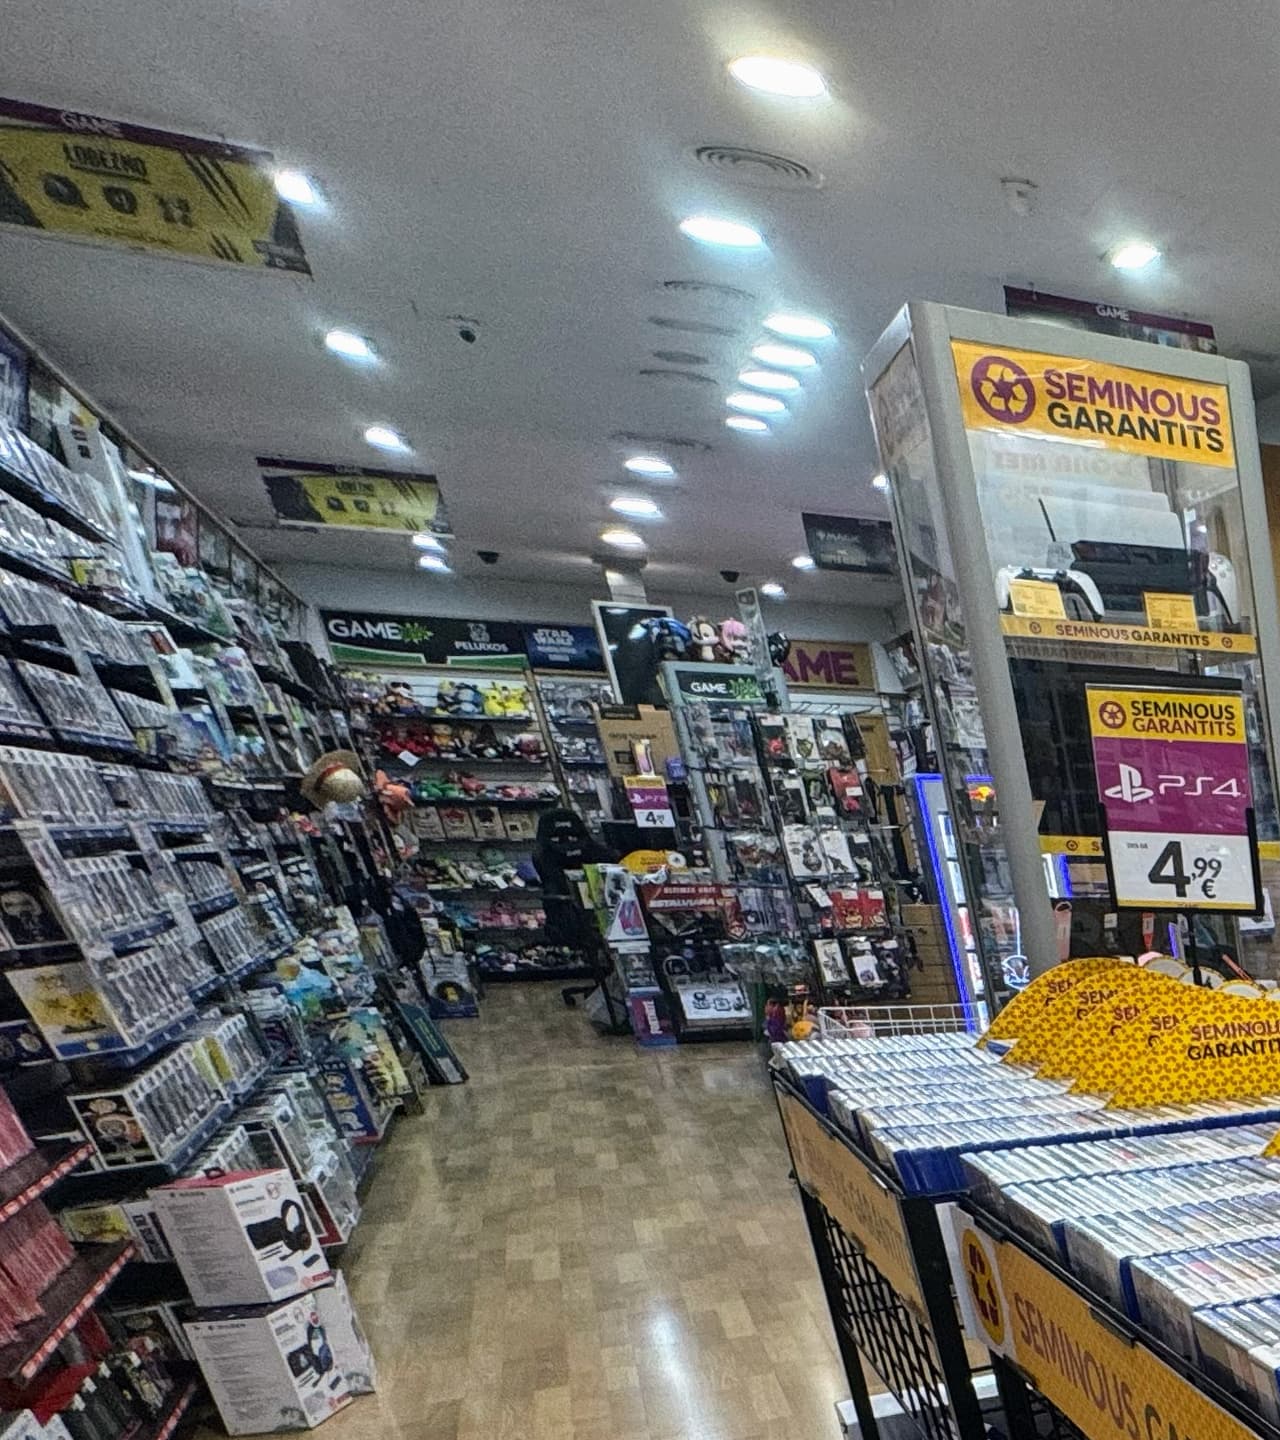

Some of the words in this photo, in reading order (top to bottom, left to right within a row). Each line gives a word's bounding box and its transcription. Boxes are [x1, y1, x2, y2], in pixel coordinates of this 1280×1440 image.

[1044, 367, 1222, 427] SEMINOUS
[1047, 402, 1225, 453] GARANTITS
[328, 619, 400, 640] GAME
[1055, 623, 1129, 643] SEMINOUS
[1131, 629, 1211, 648] GARANTITS
[1130, 698, 1236, 723] SEMINOUS
[1131, 716, 1237, 737] GARANTITS
[1158, 775, 1241, 798] PS4
